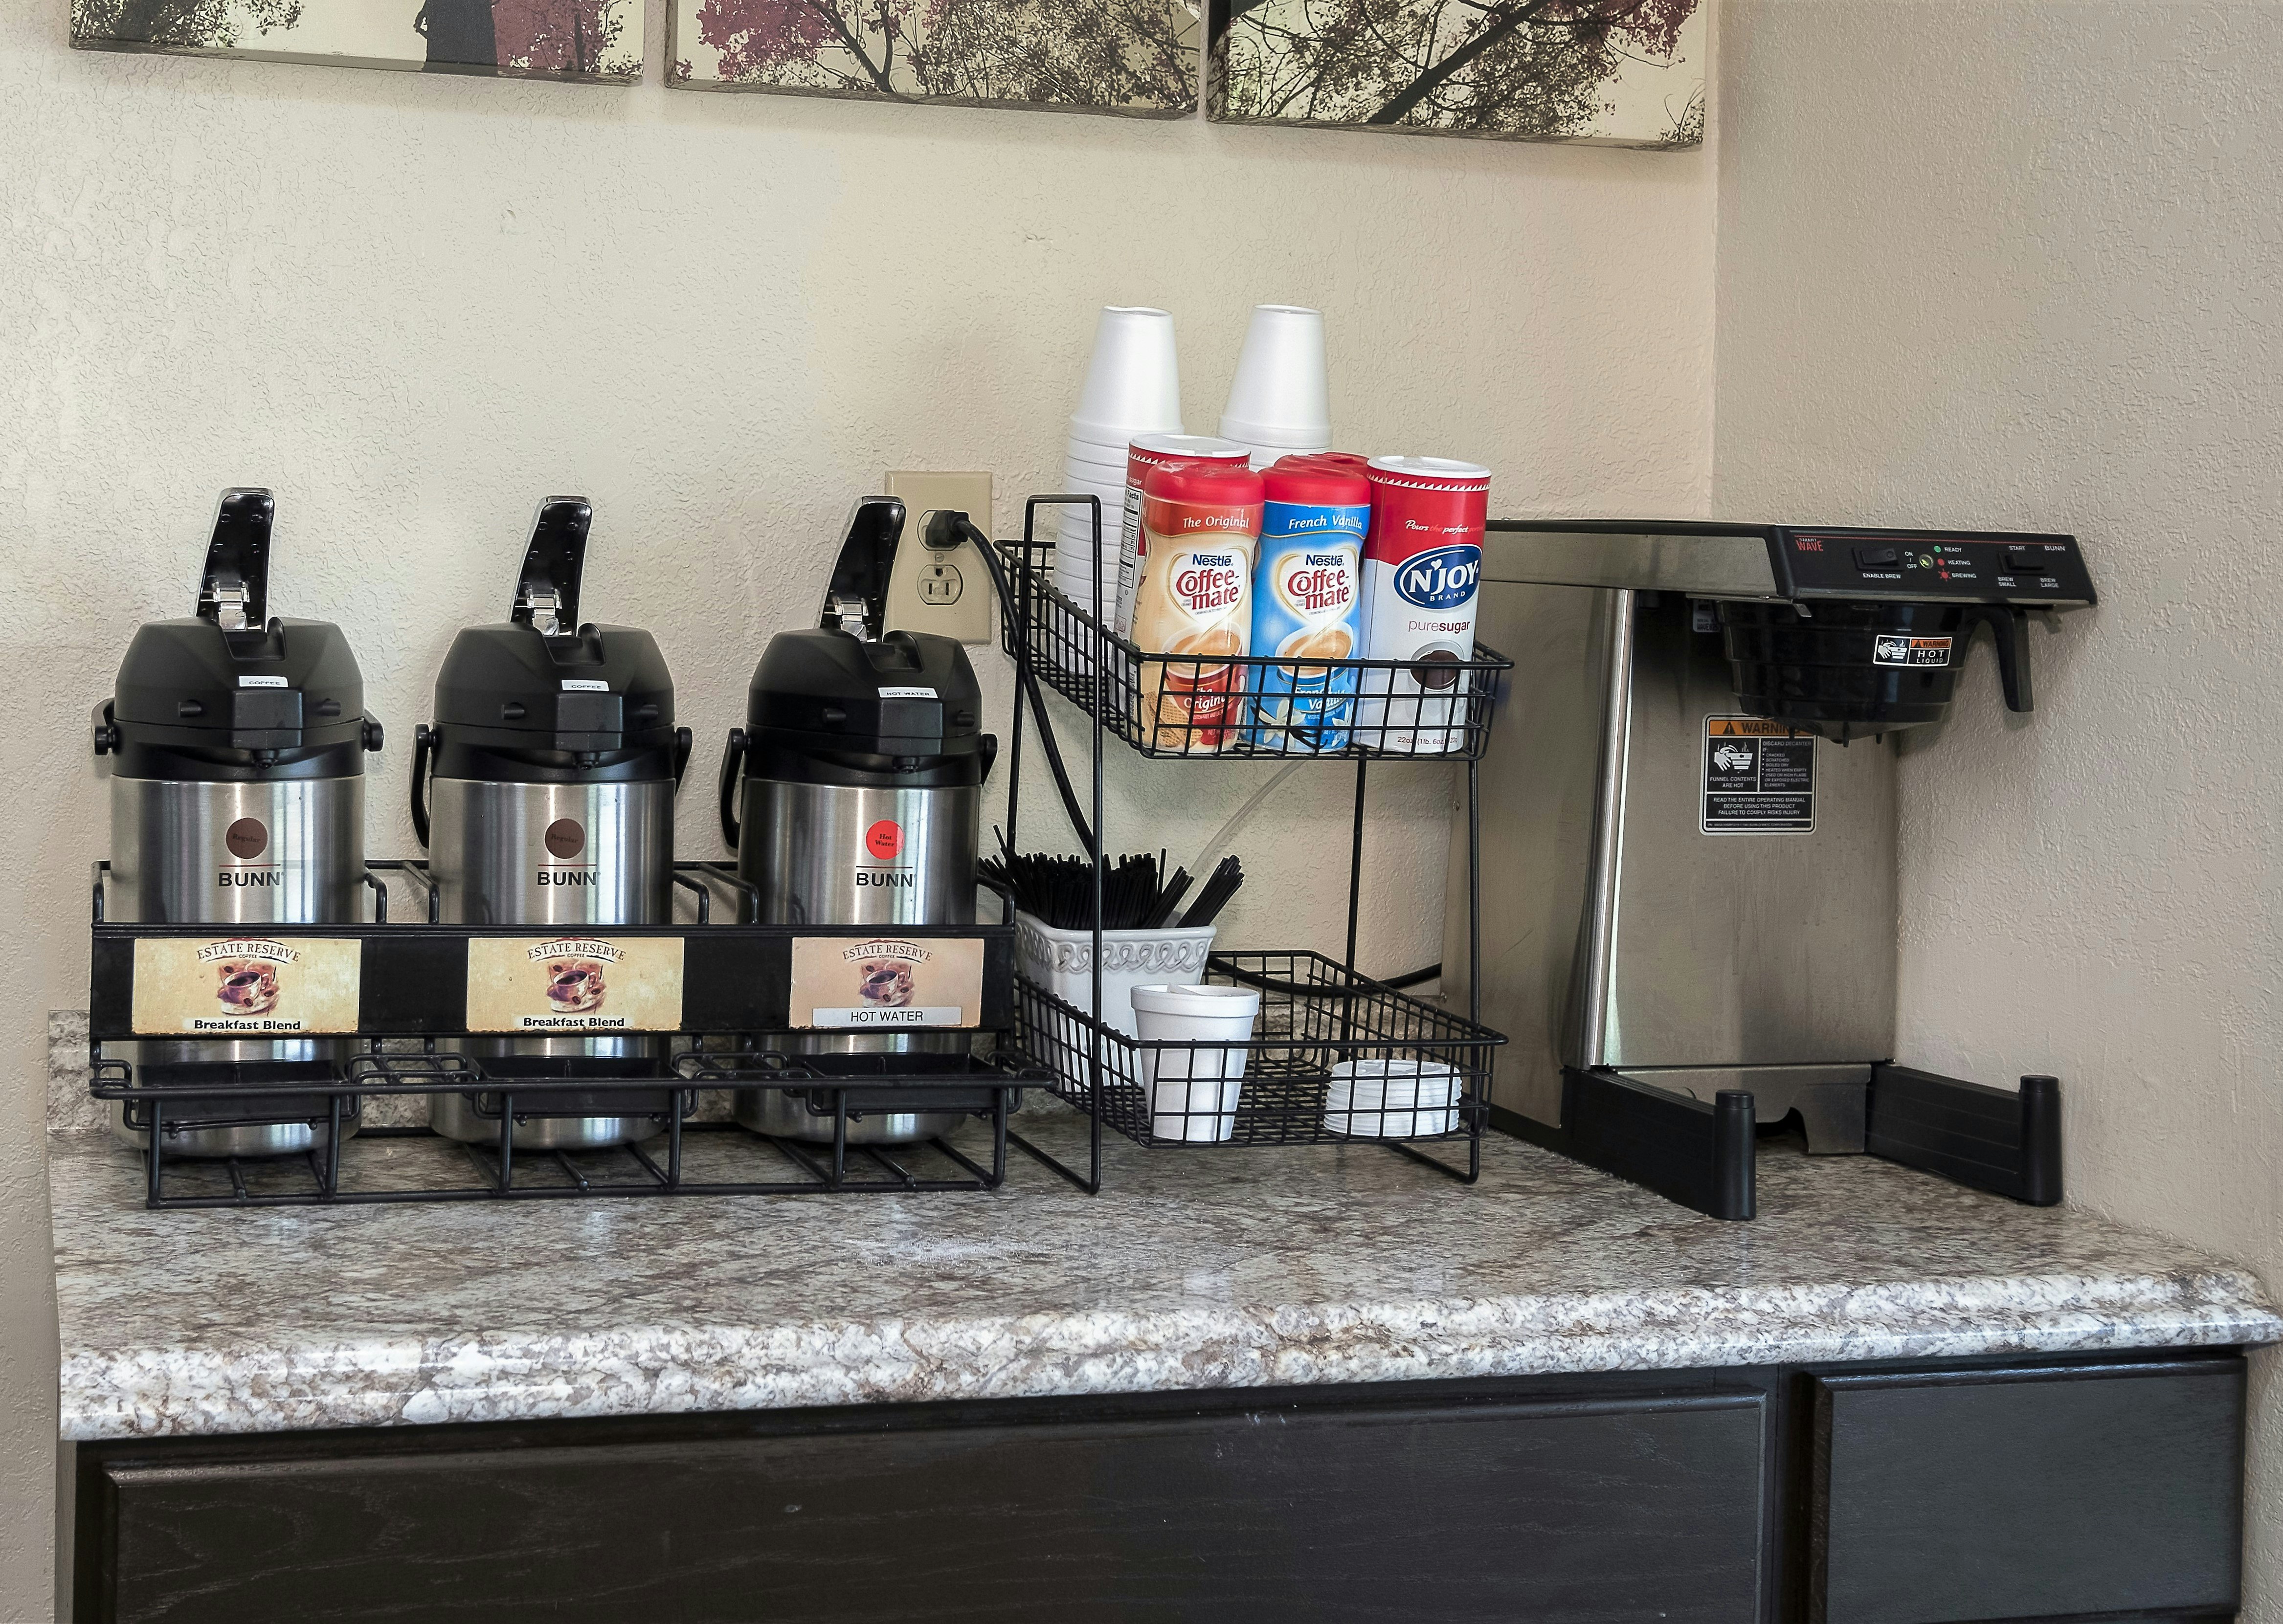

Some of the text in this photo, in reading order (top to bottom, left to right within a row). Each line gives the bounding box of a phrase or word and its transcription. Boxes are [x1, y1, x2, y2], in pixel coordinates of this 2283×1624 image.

[1184, 516, 1249, 529] The Original
[1289, 515, 1363, 530] French Vanilla
[1405, 520, 1429, 531] Pours
[1442, 524, 1469, 535] perfect
[1795, 539, 1824, 551] WAVE
[1191, 586, 1239, 610] mate
[1305, 586, 1349, 610] mate
[1430, 591, 1466, 601] BRAND
[1741, 723, 1801, 734] WARNIN
[233, 833, 261, 842] Regular
[551, 834, 579, 843] Regular
[219, 872, 280, 887] BUNN
[537, 872, 597, 886] BUNN
[856, 873, 913, 887] BUNN
[197, 943, 301, 962] ESTATE RESERVE
[527, 943, 626, 960] ESTATE RESERVE
[843, 944, 933, 961] ESTATE RESERVE
[523, 1018, 625, 1026] Breakfast Blend
[851, 1011, 923, 1022] HOT WATER
[195, 1020, 301, 1030] Breakfast Blend
